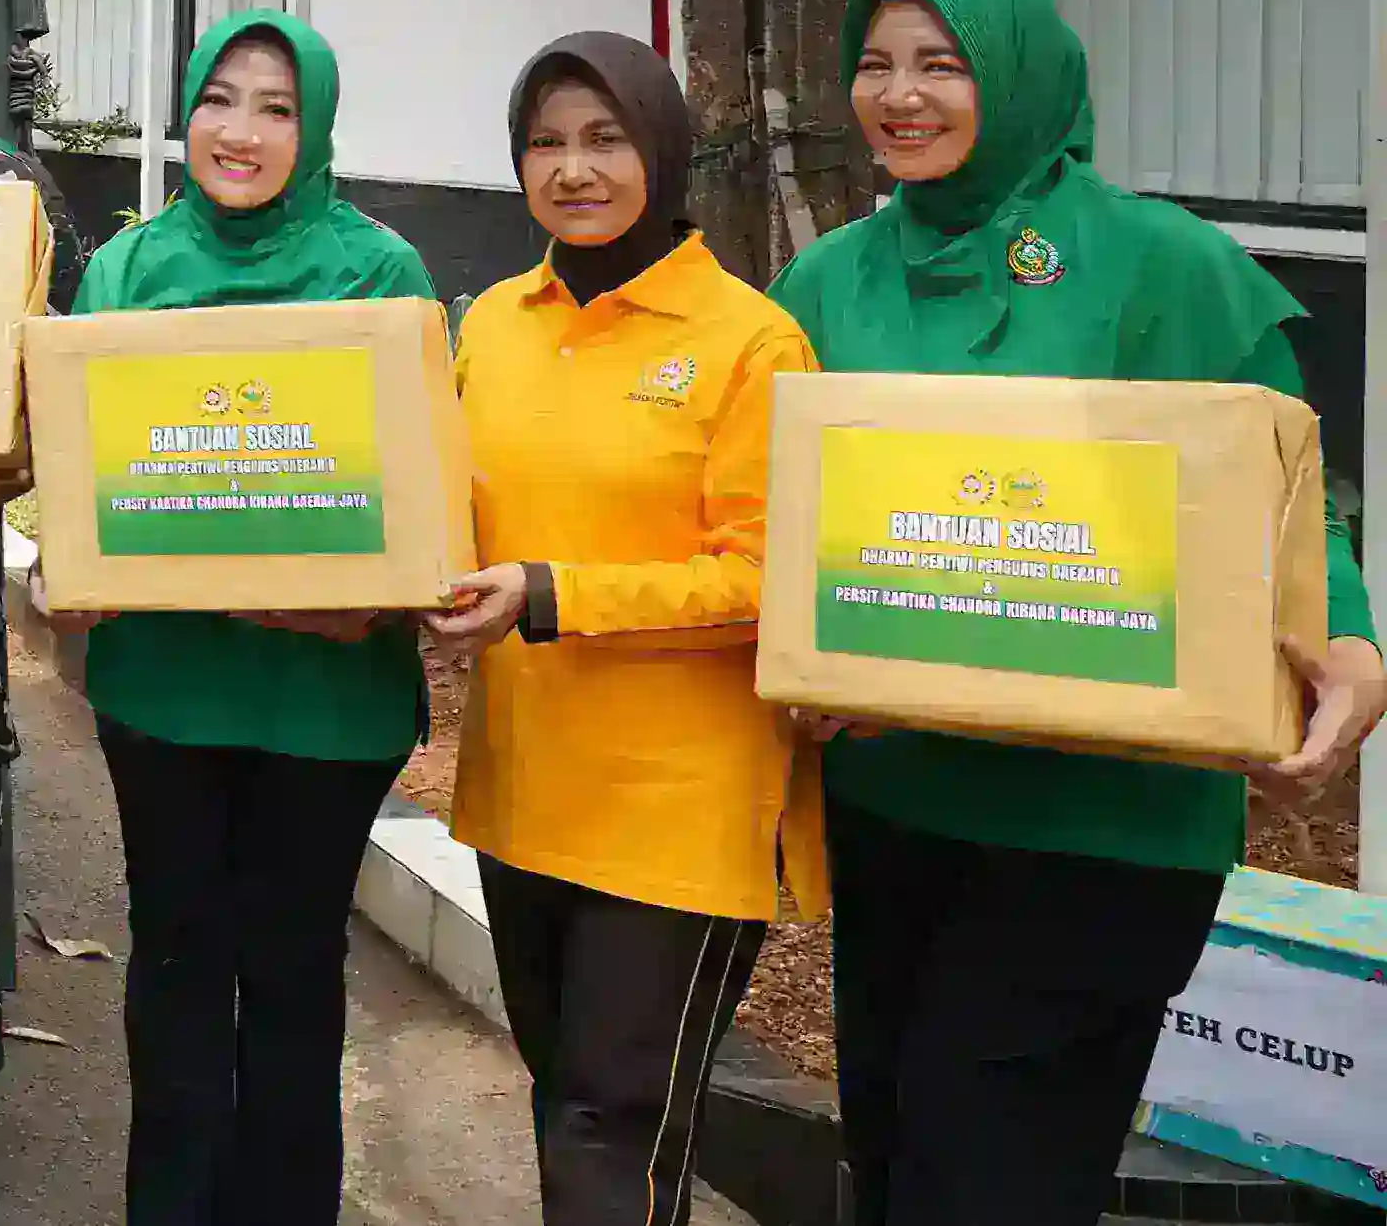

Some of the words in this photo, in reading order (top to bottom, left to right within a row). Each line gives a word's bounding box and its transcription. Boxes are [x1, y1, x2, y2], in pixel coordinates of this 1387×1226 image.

[150, 425, 239, 453] BANTUAN
[245, 423, 316, 451] SOSIAL
[889, 510, 1000, 548] BANTUAN
[1007, 520, 1096, 556] SOSIAL
[860, 548, 914, 568] DHARMA
[982, 581, 996, 594] &
[835, 586, 879, 604] PERSIT
[882, 591, 935, 611] KARTIKA
[939, 596, 1002, 617] CHANDRA
[1005, 601, 1056, 621] KIRANA
[1060, 606, 1116, 627] DAERAH
[1120, 611, 1157, 632] JAYA
[1235, 1026, 1354, 1077] CELUP
